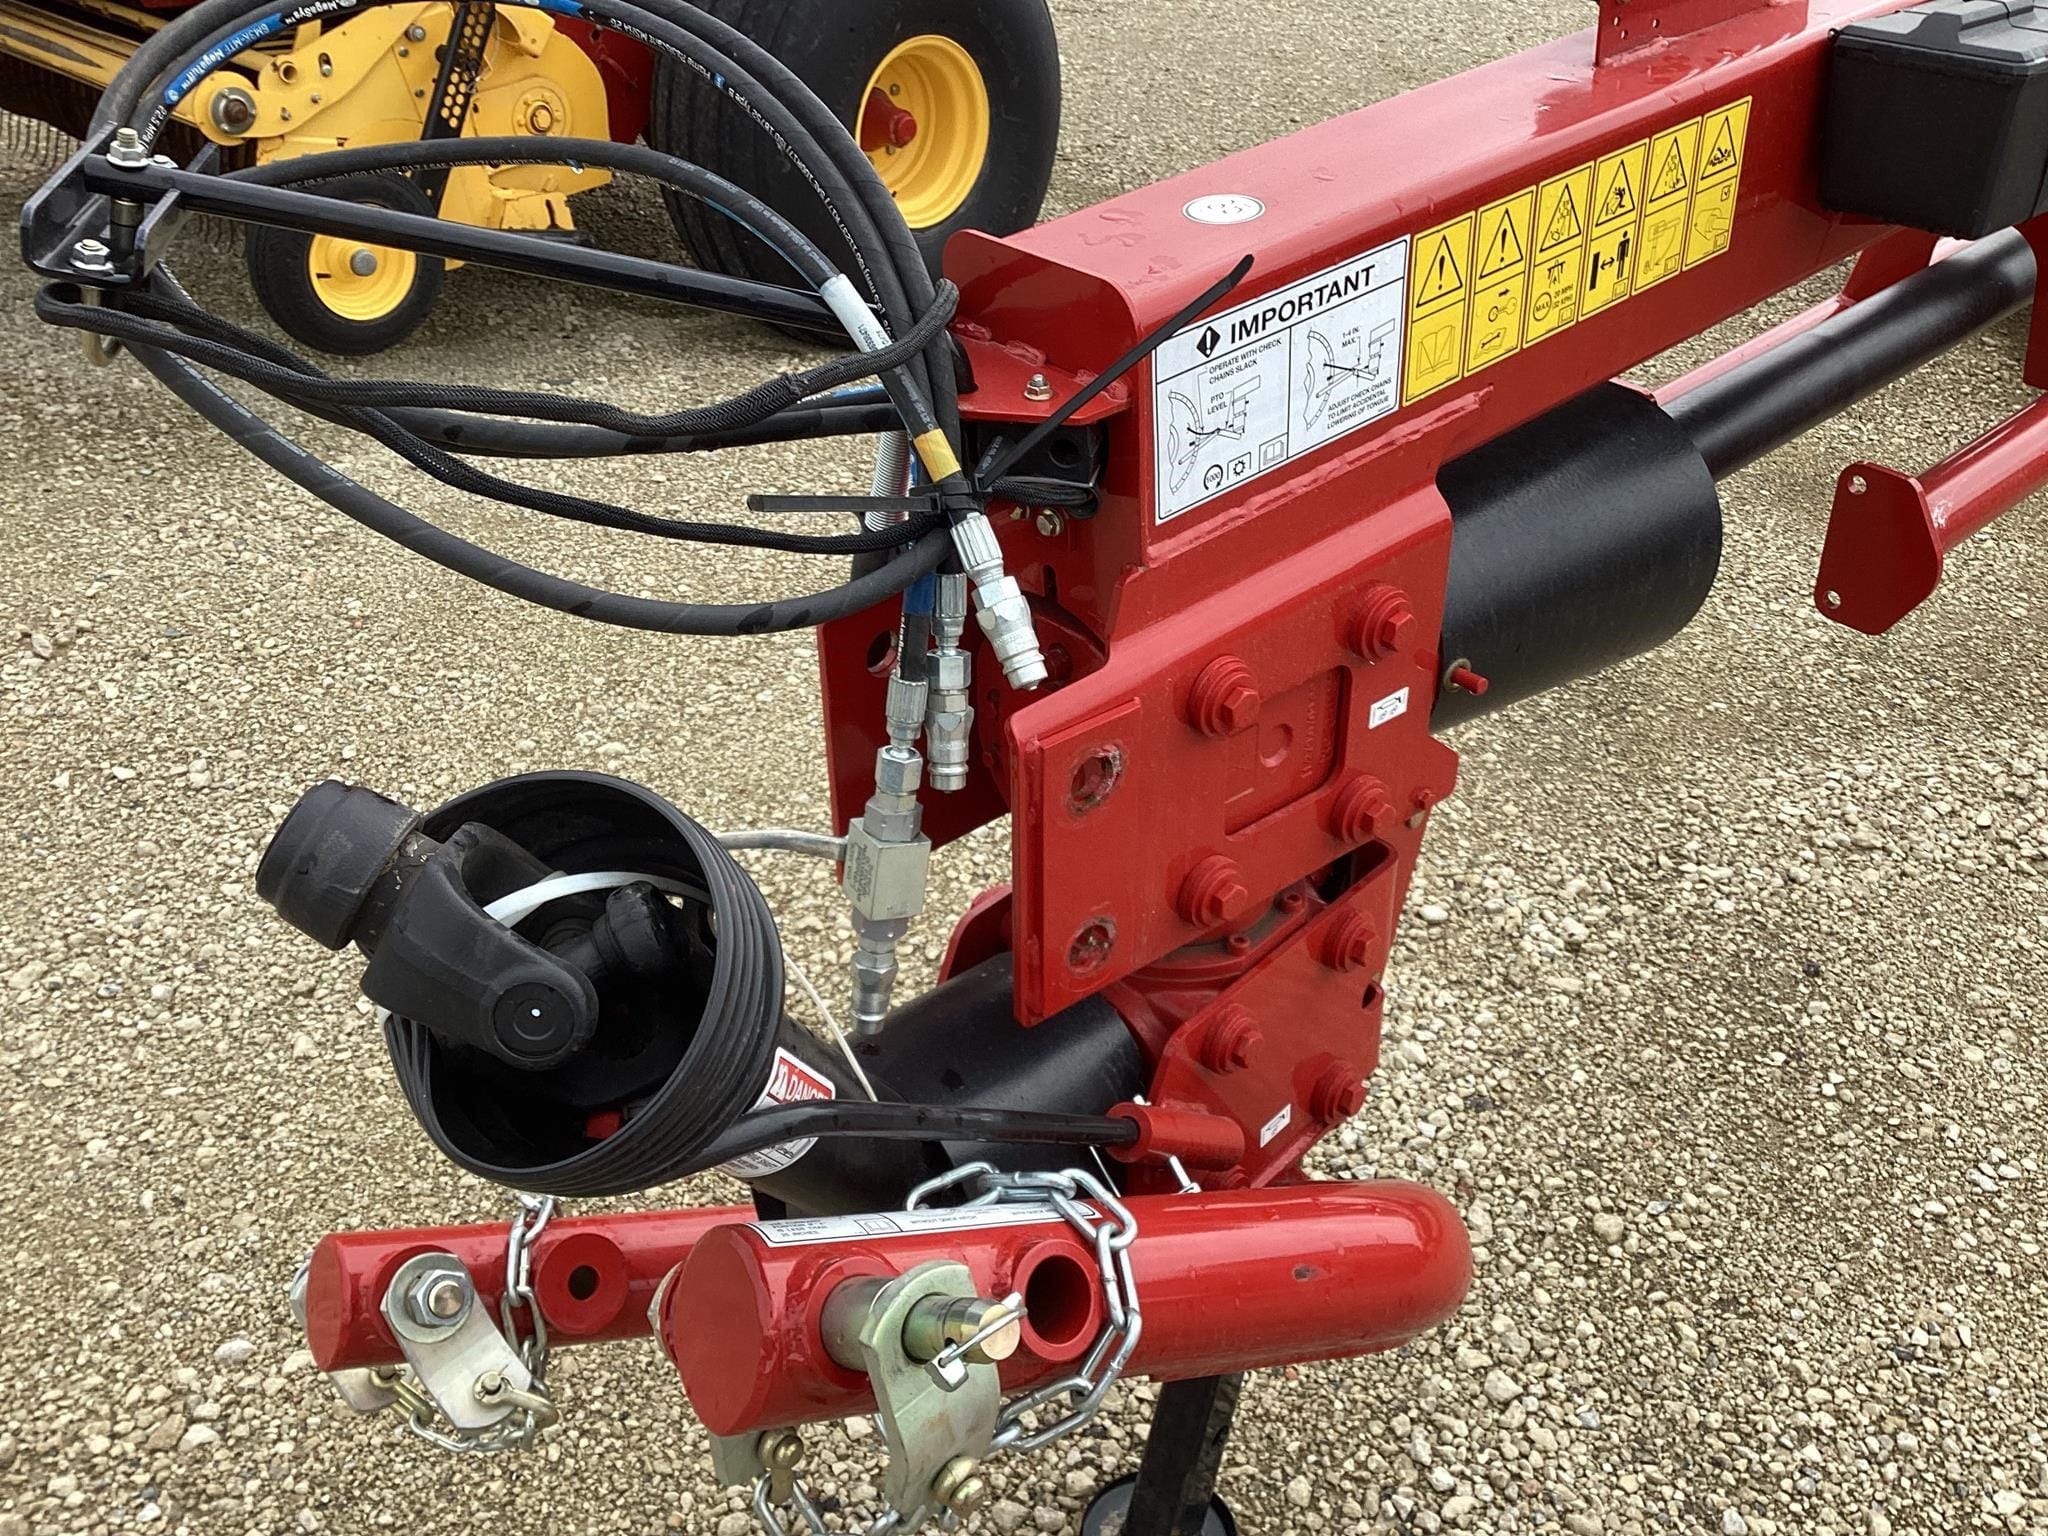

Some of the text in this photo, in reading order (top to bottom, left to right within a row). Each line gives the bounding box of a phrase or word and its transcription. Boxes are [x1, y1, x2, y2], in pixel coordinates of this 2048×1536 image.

[1230, 264, 1376, 345] IMPORTANT
[1535, 301, 1550, 312] MAX
[1209, 337, 1283, 374] OPERATE WITH CHECK
[1209, 358, 1258, 385] CHAINS SLACK
[1207, 401, 1228, 415] LEVEL
[1210, 392, 1225, 404] PTO
[1328, 377, 1392, 412] ADJUST CHECK CHAINS
[1328, 412, 1336, 421] TO
[1336, 404, 1351, 417] LIMIT
[1352, 389, 1386, 409] ACCIDENTAL
[1328, 410, 1357, 430] LOWERING
[1357, 406, 1366, 415] OF
[1366, 395, 1389, 411] TONGUE
[1206, 470, 1220, 484] 1000
